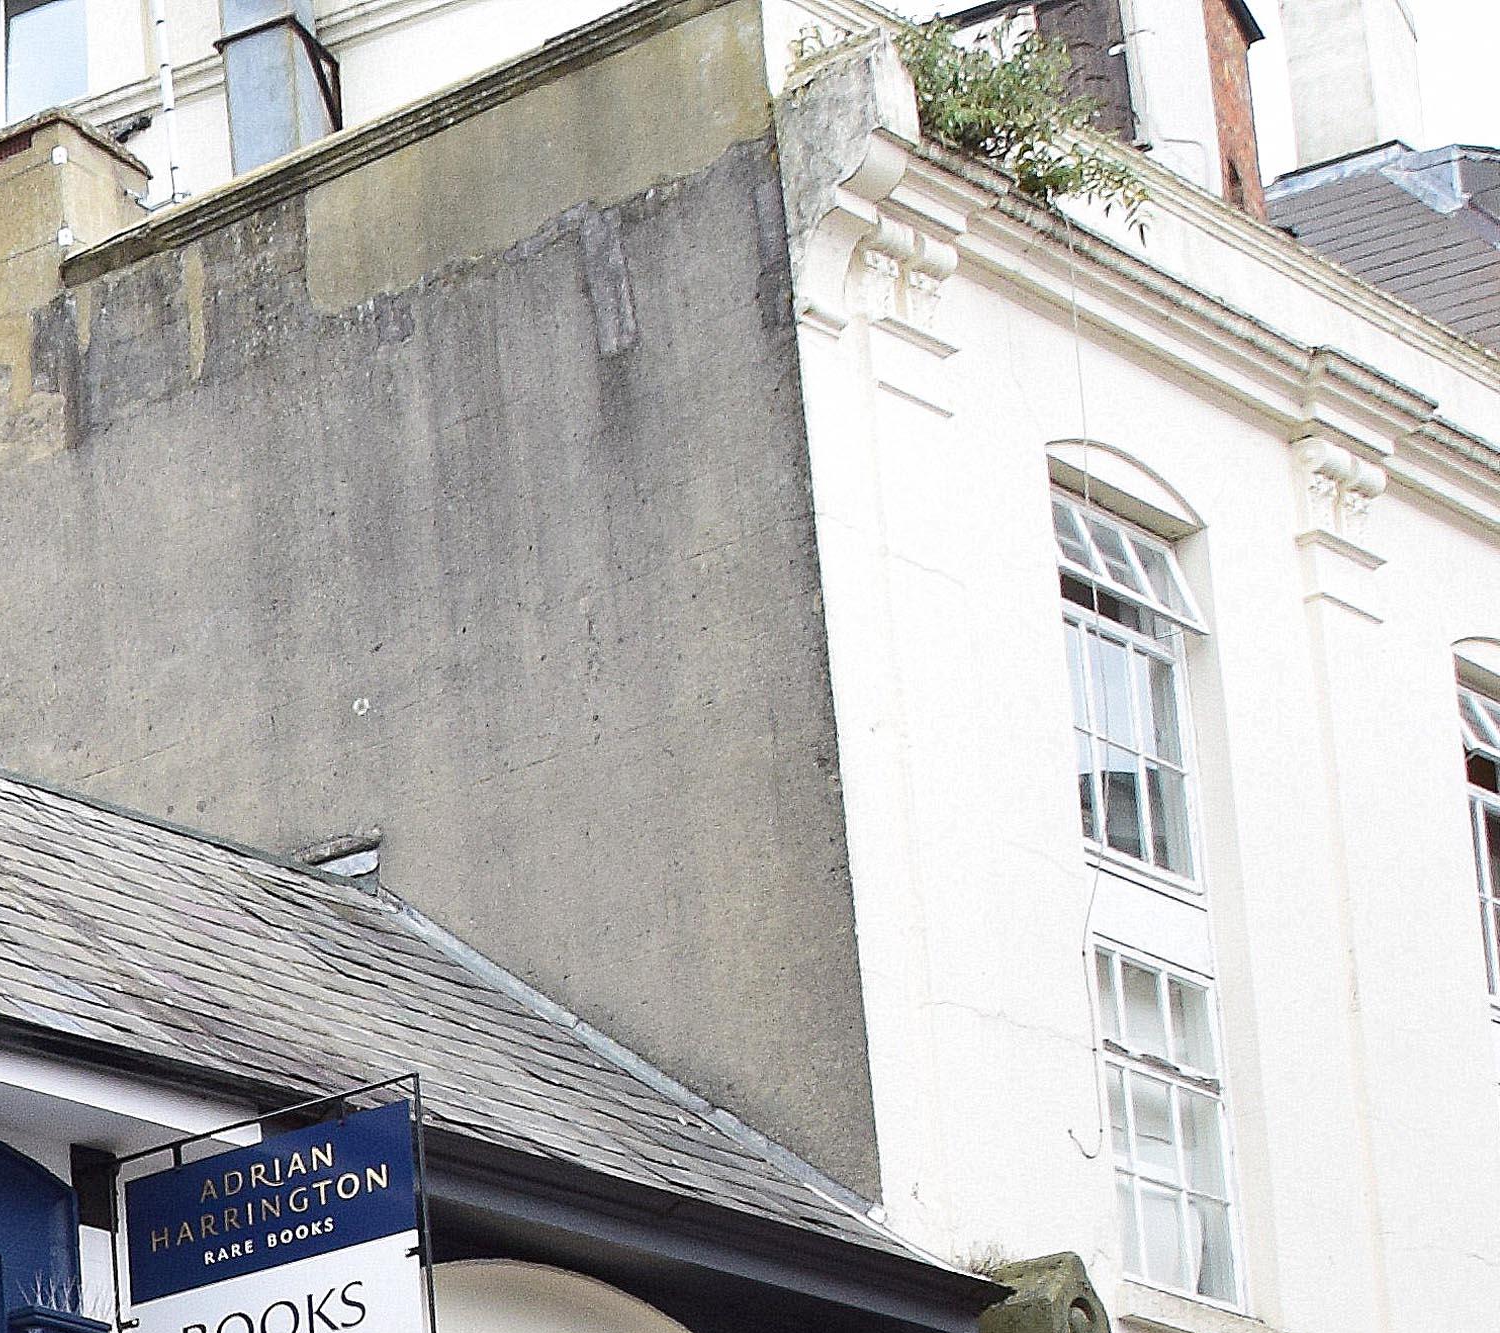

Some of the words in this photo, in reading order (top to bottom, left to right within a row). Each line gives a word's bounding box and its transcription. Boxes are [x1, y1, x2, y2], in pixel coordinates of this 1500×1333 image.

[199, 1142, 335, 1202] ADRIAN
[152, 1162, 389, 1251] HARRINGTON
[204, 1239, 254, 1265] RARE
[267, 1216, 336, 1248] BOOKS
